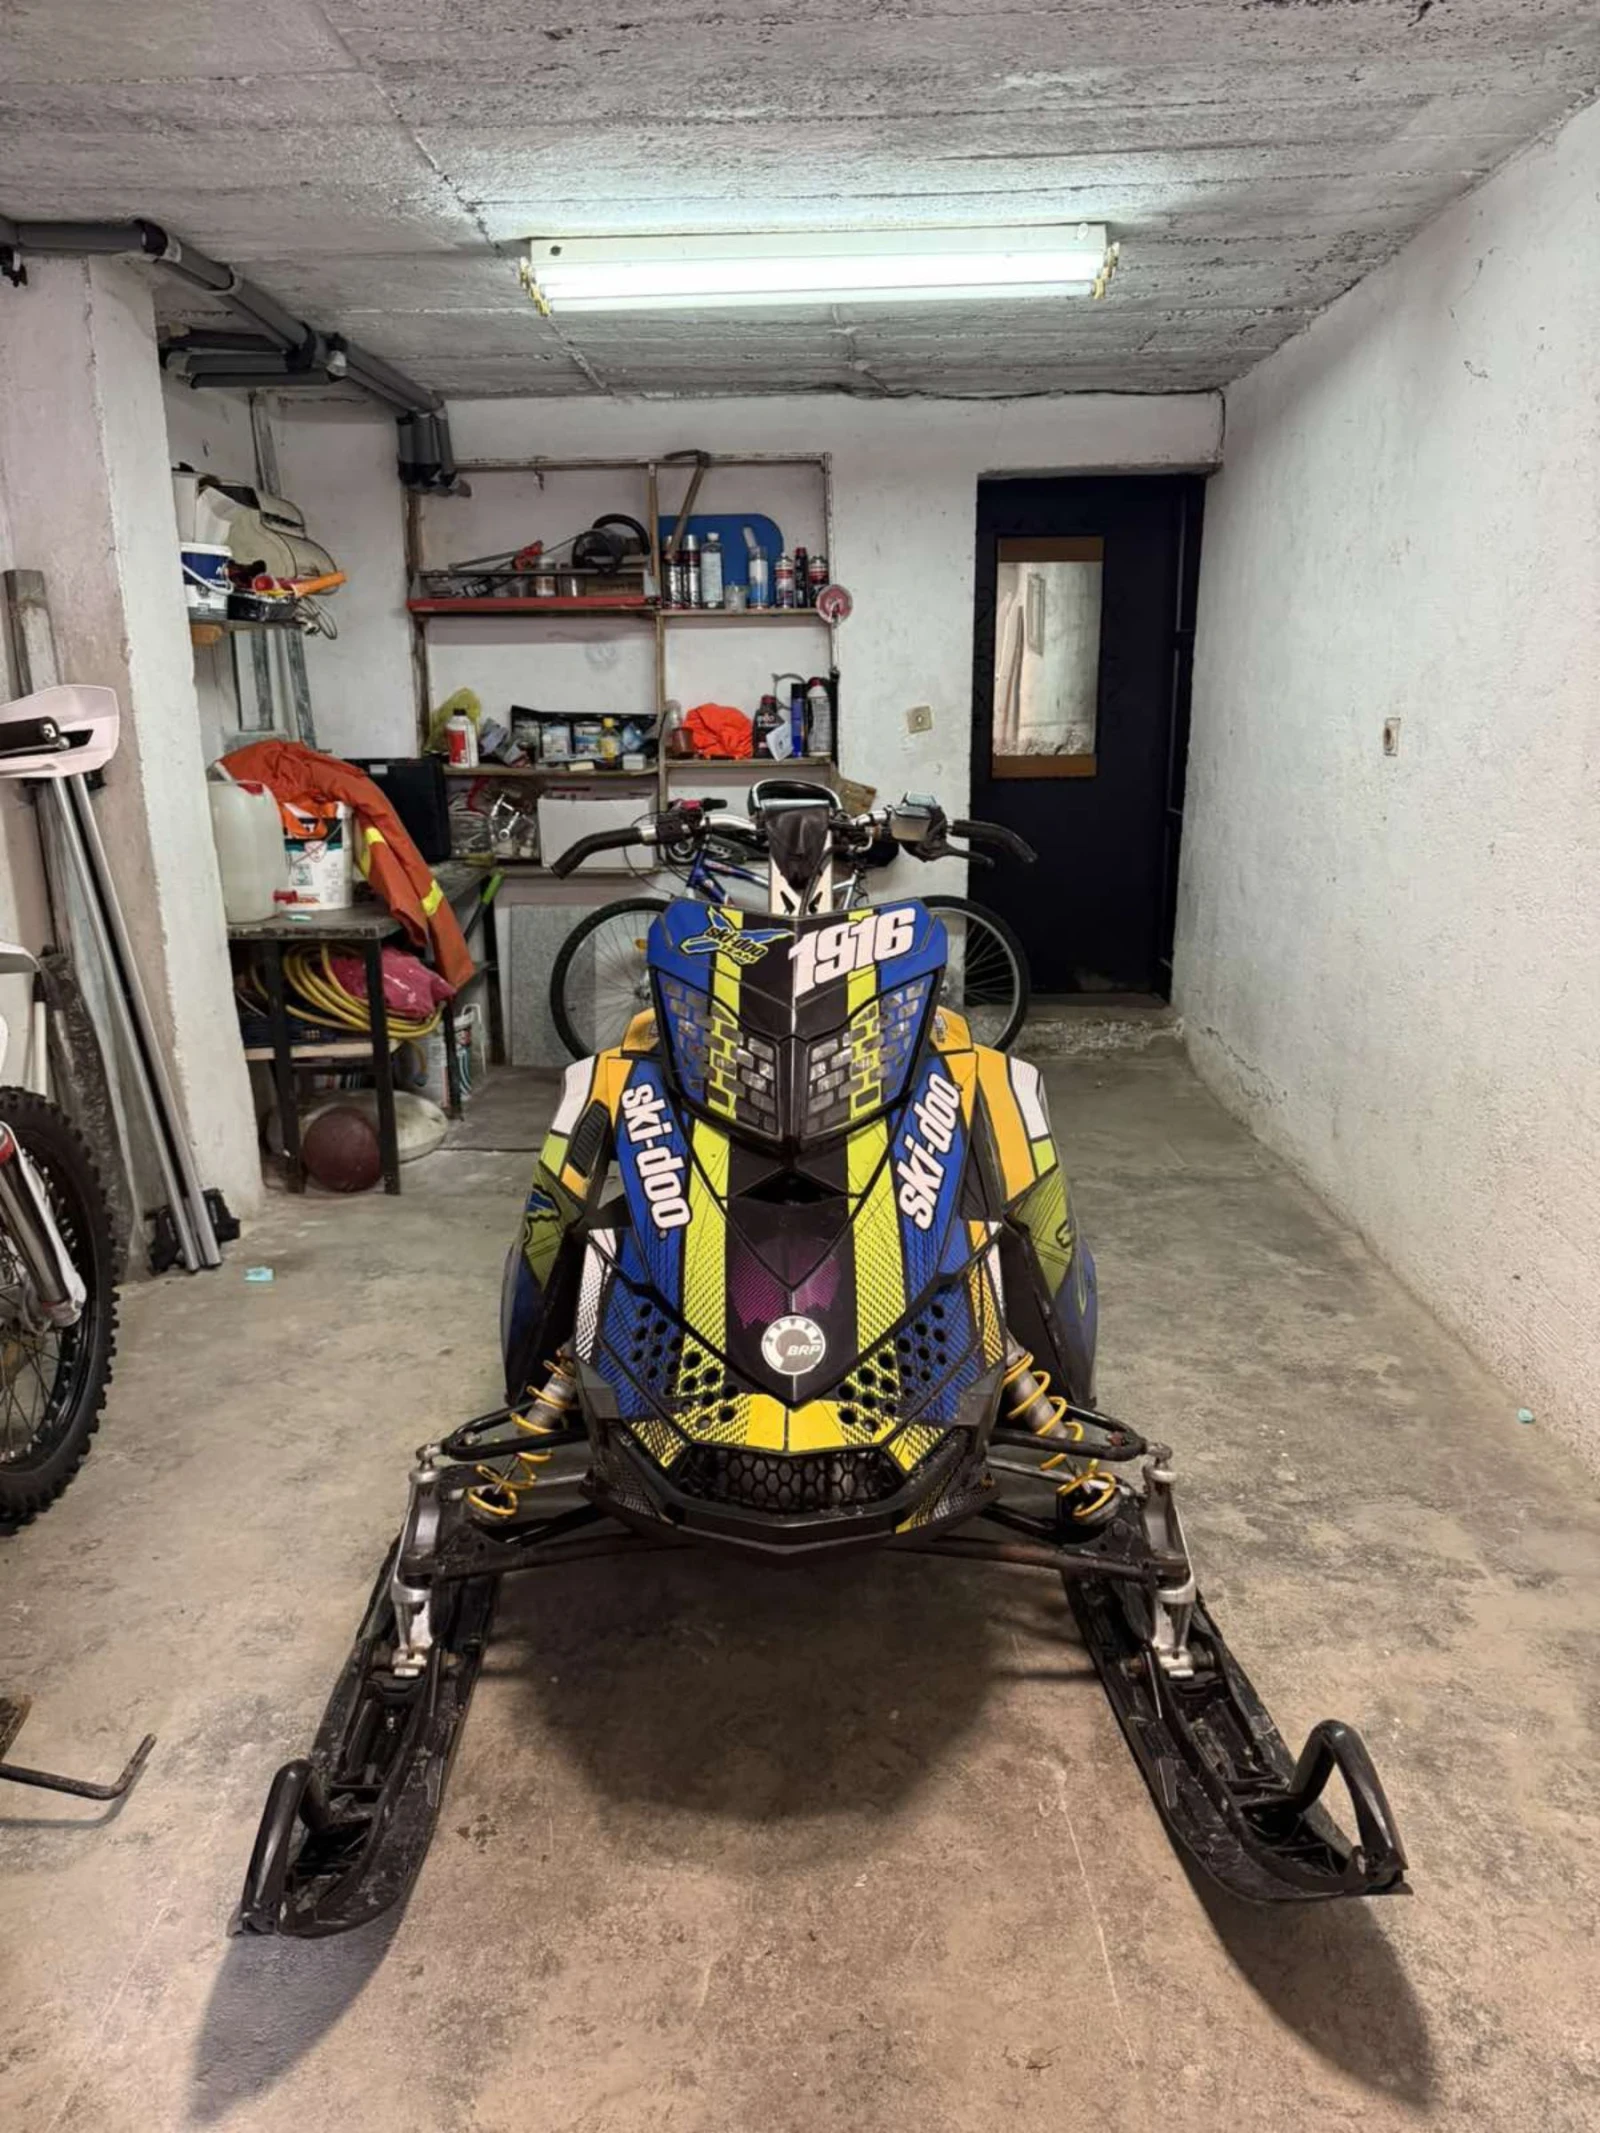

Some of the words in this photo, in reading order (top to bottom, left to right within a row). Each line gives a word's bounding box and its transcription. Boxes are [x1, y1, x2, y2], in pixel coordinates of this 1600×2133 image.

[706, 926, 767, 957] ski-doo
[788, 907, 916, 998] 1916
[621, 1084, 692, 1229] ski-doo
[900, 1073, 960, 1230] ski-doo
[786, 1344, 821, 1356] BRP
